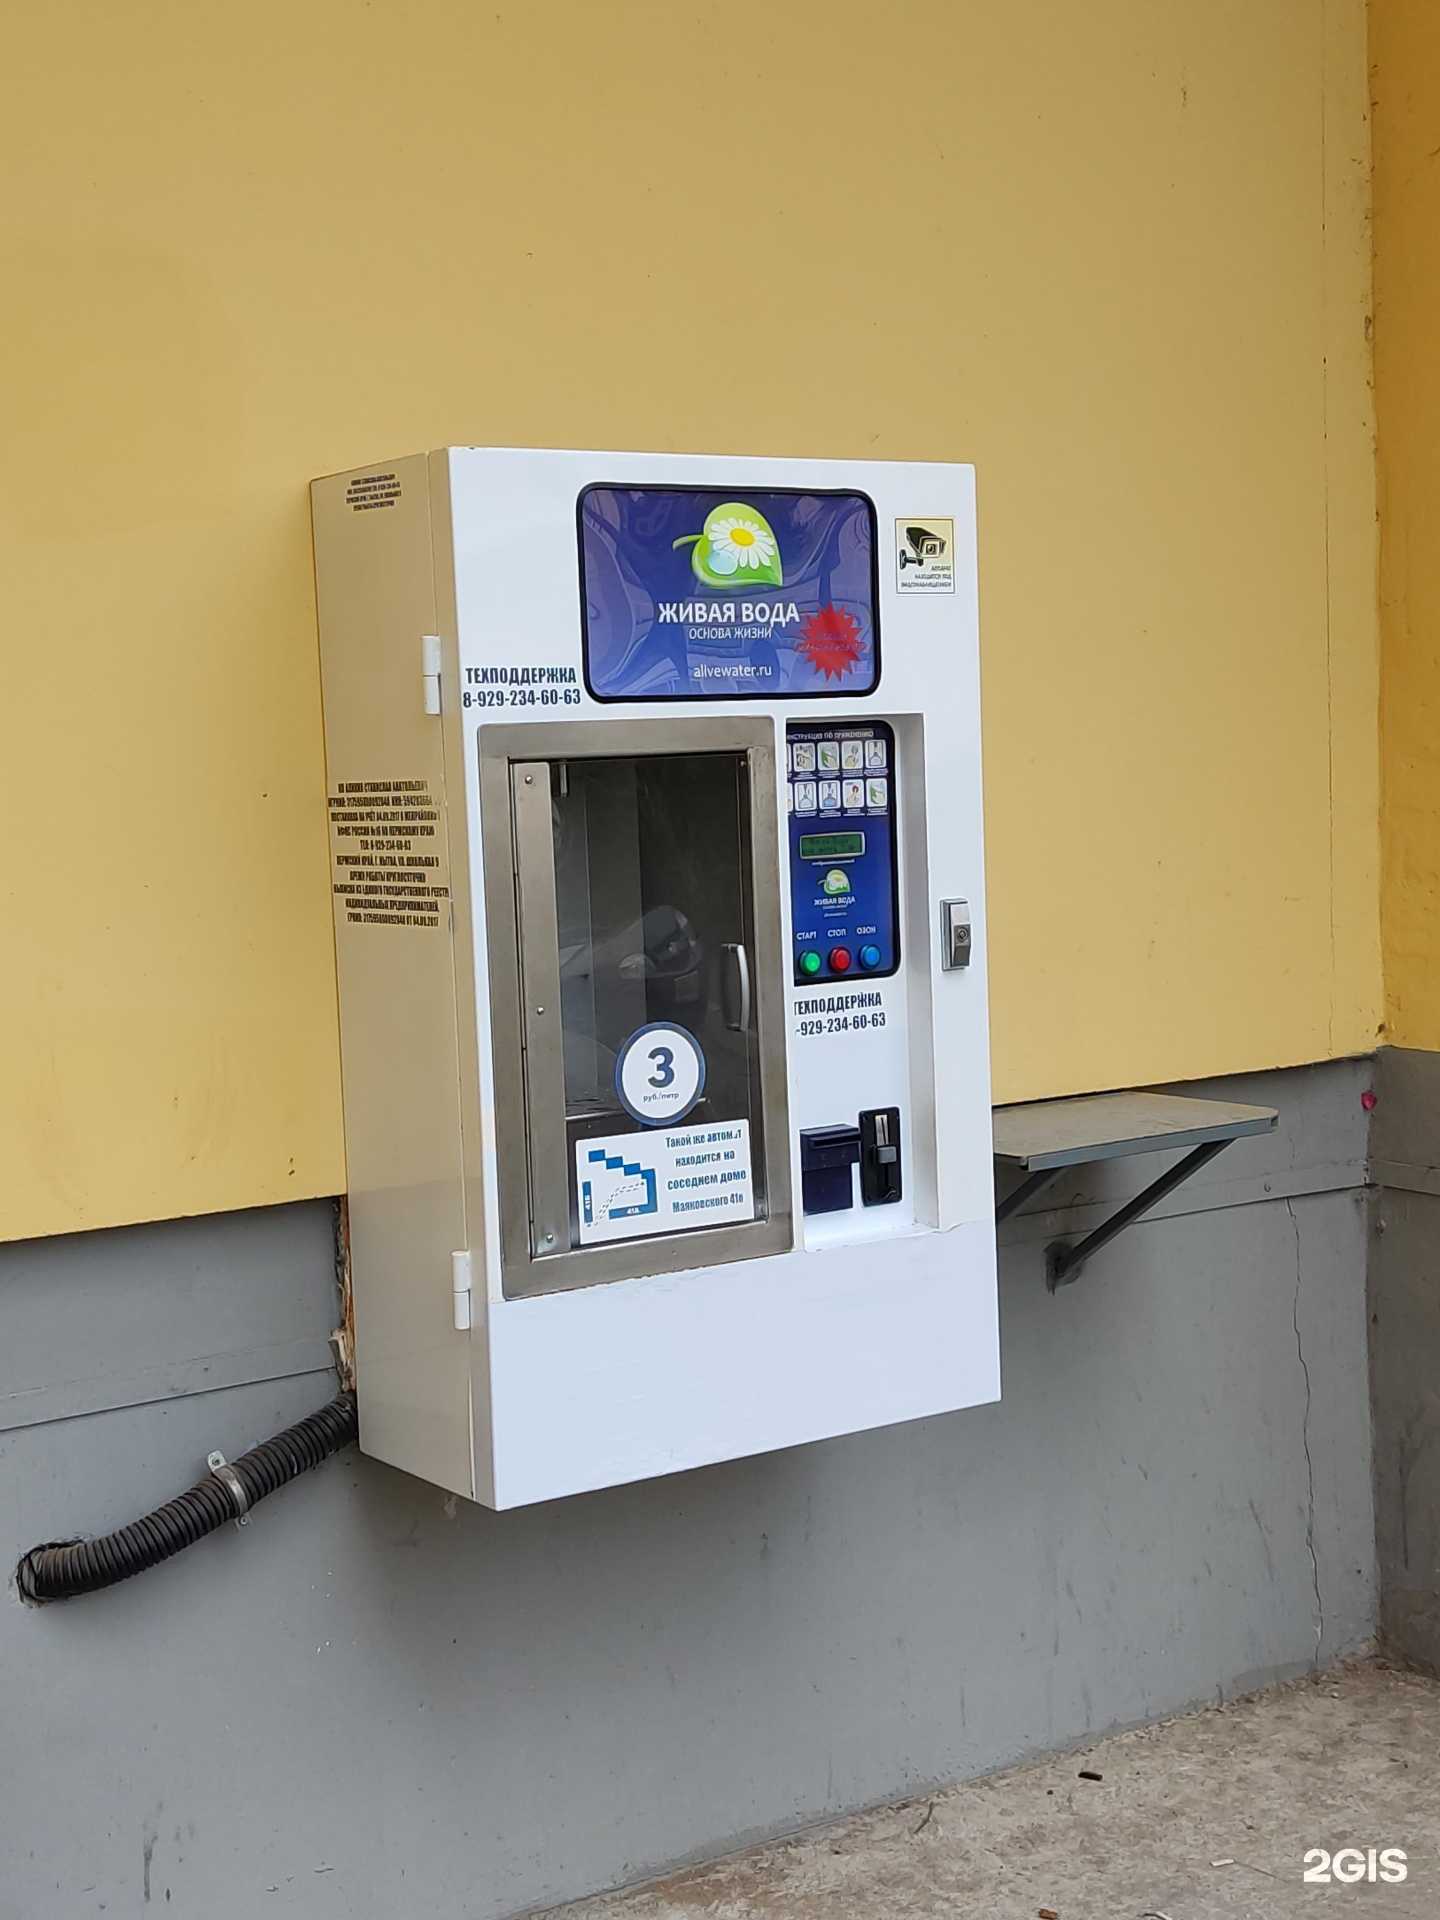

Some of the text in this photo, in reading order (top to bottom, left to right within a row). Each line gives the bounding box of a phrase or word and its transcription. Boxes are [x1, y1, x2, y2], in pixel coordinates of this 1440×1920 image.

[658, 603, 800, 628] ЖИВАЯ ВОДА
[689, 626, 772, 640] ОСНОВА ЖИЗНИ
[465, 667, 577, 686] ТЕХПОДДЕРЖКА
[463, 689, 581, 708] 8-929-234-60-63
[796, 926, 876, 940] СТАРТ СТОП ОЗОН
[796, 1012, 886, 1036] -929-234-60-63
[648, 1047, 675, 1088] 3
[666, 1134, 692, 1148] Такой
[675, 1150, 735, 1167] находится на
[667, 1170, 746, 1191] соседнем доме
[672, 1195, 729, 1213] Маяковского
